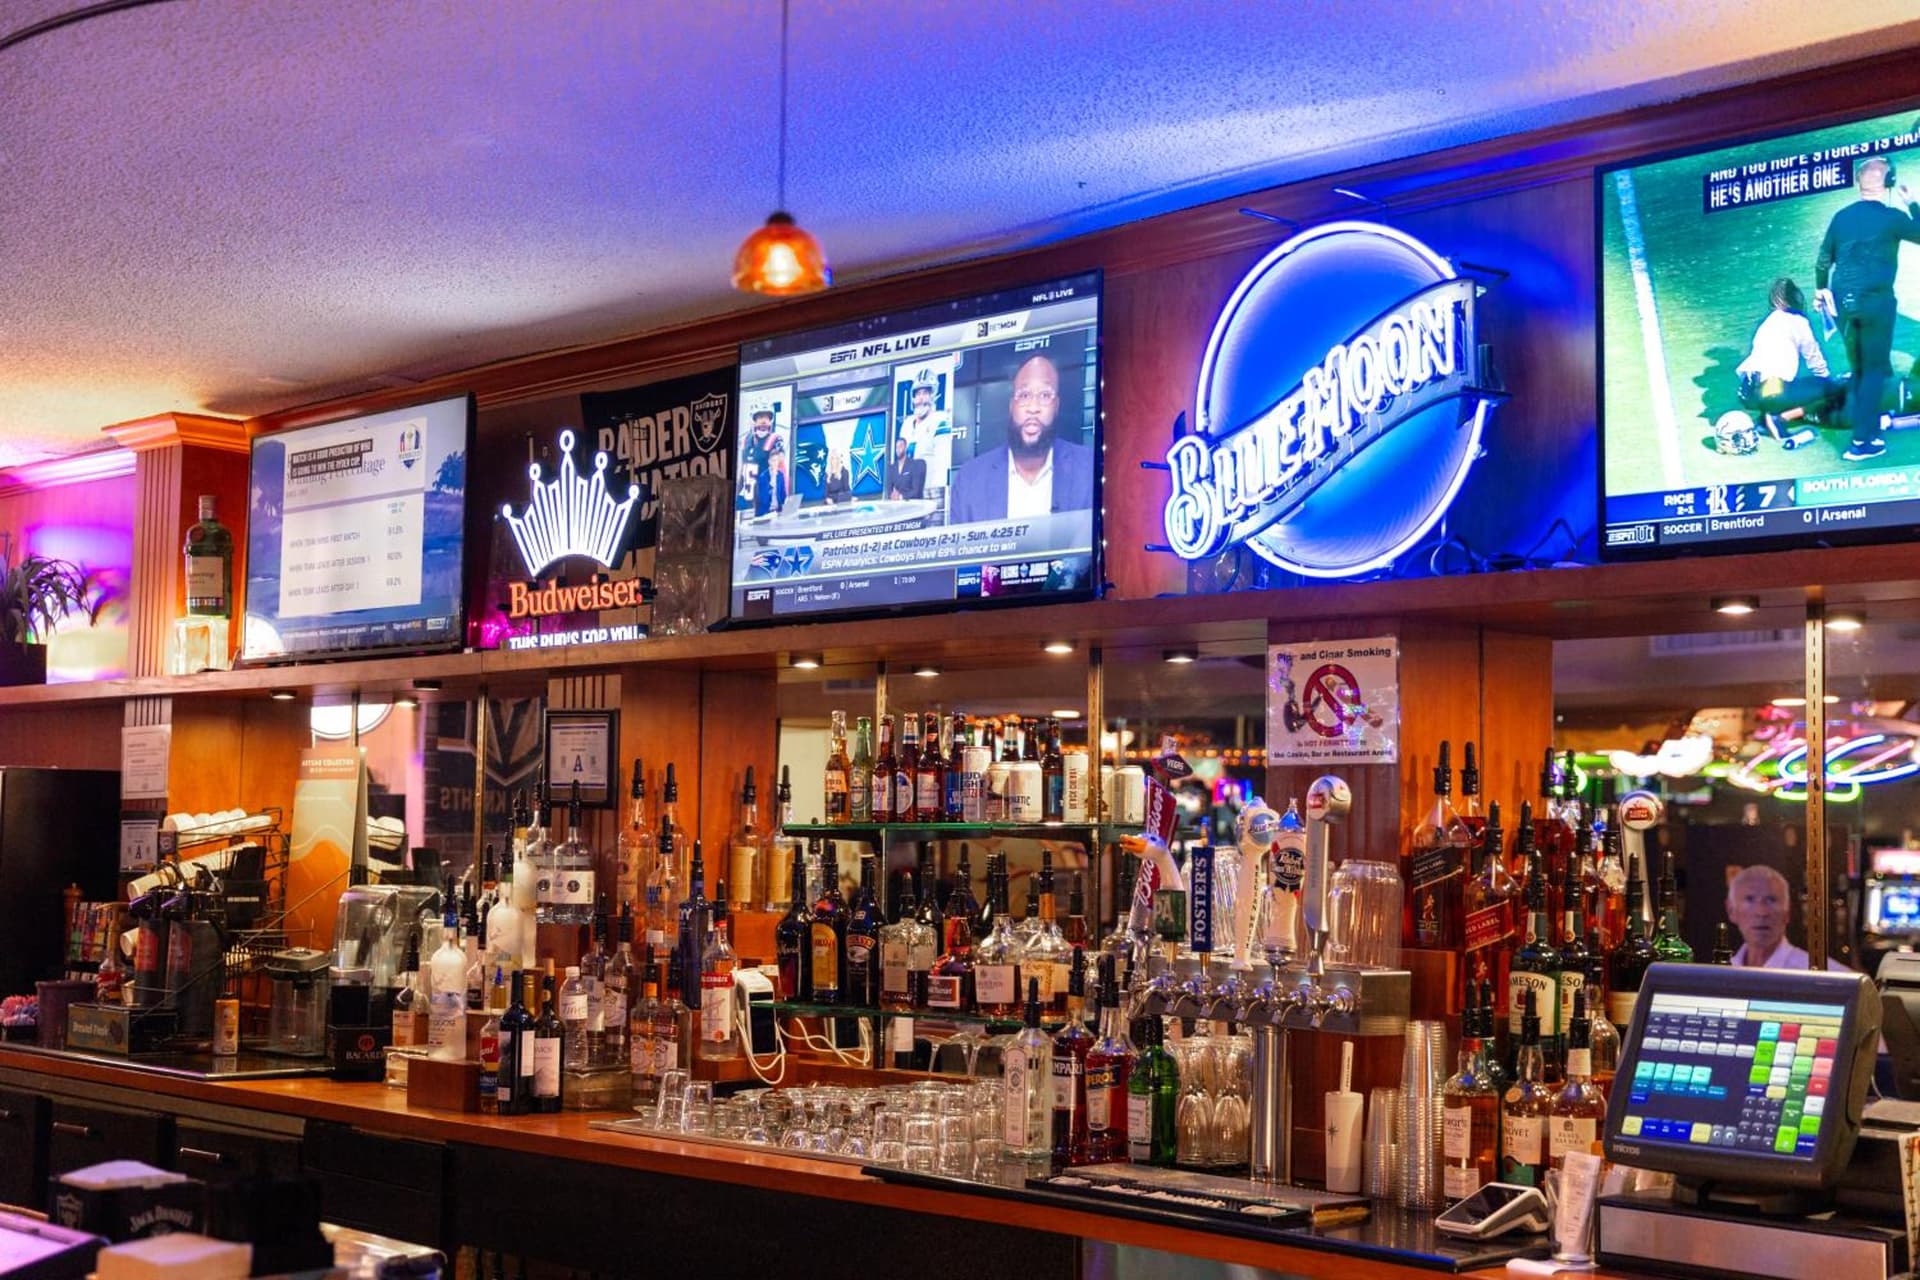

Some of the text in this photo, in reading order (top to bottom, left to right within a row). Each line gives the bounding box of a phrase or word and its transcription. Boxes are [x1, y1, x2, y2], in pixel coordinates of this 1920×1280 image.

[1710, 185, 1742, 209] HE'S
[1745, 172, 1810, 203] ANOTHER
[1032, 287, 1075, 304] NFL LIVE
[830, 333, 931, 365] ESPN NFL LIVE
[1014, 334, 1051, 353] ESPN
[1663, 493, 1695, 507] RICE
[1758, 484, 1777, 508] 7
[1663, 522, 1703, 535] SOCCER
[1711, 514, 1765, 532] Brentford
[1820, 505, 1867, 522] Arsenal
[822, 543, 859, 557] Patriots
[882, 541, 893, 551] at
[894, 535, 936, 550] Cowboys
[990, 527, 1014, 539] 4:25
[1014, 524, 1030, 537] ET
[747, 588, 770, 601] ESPN
[1300, 651, 1317, 661] and
[1346, 647, 1392, 660] Smoking
[1332, 749, 1370, 757] Restaurant
[573, 754, 585, 772] A
[1194, 856, 1208, 943] FOSTER'S
[1477, 915, 1500, 930] LABEL
[1053, 1062, 1083, 1077] MPARI
[1613, 1143, 1640, 1155] micros
